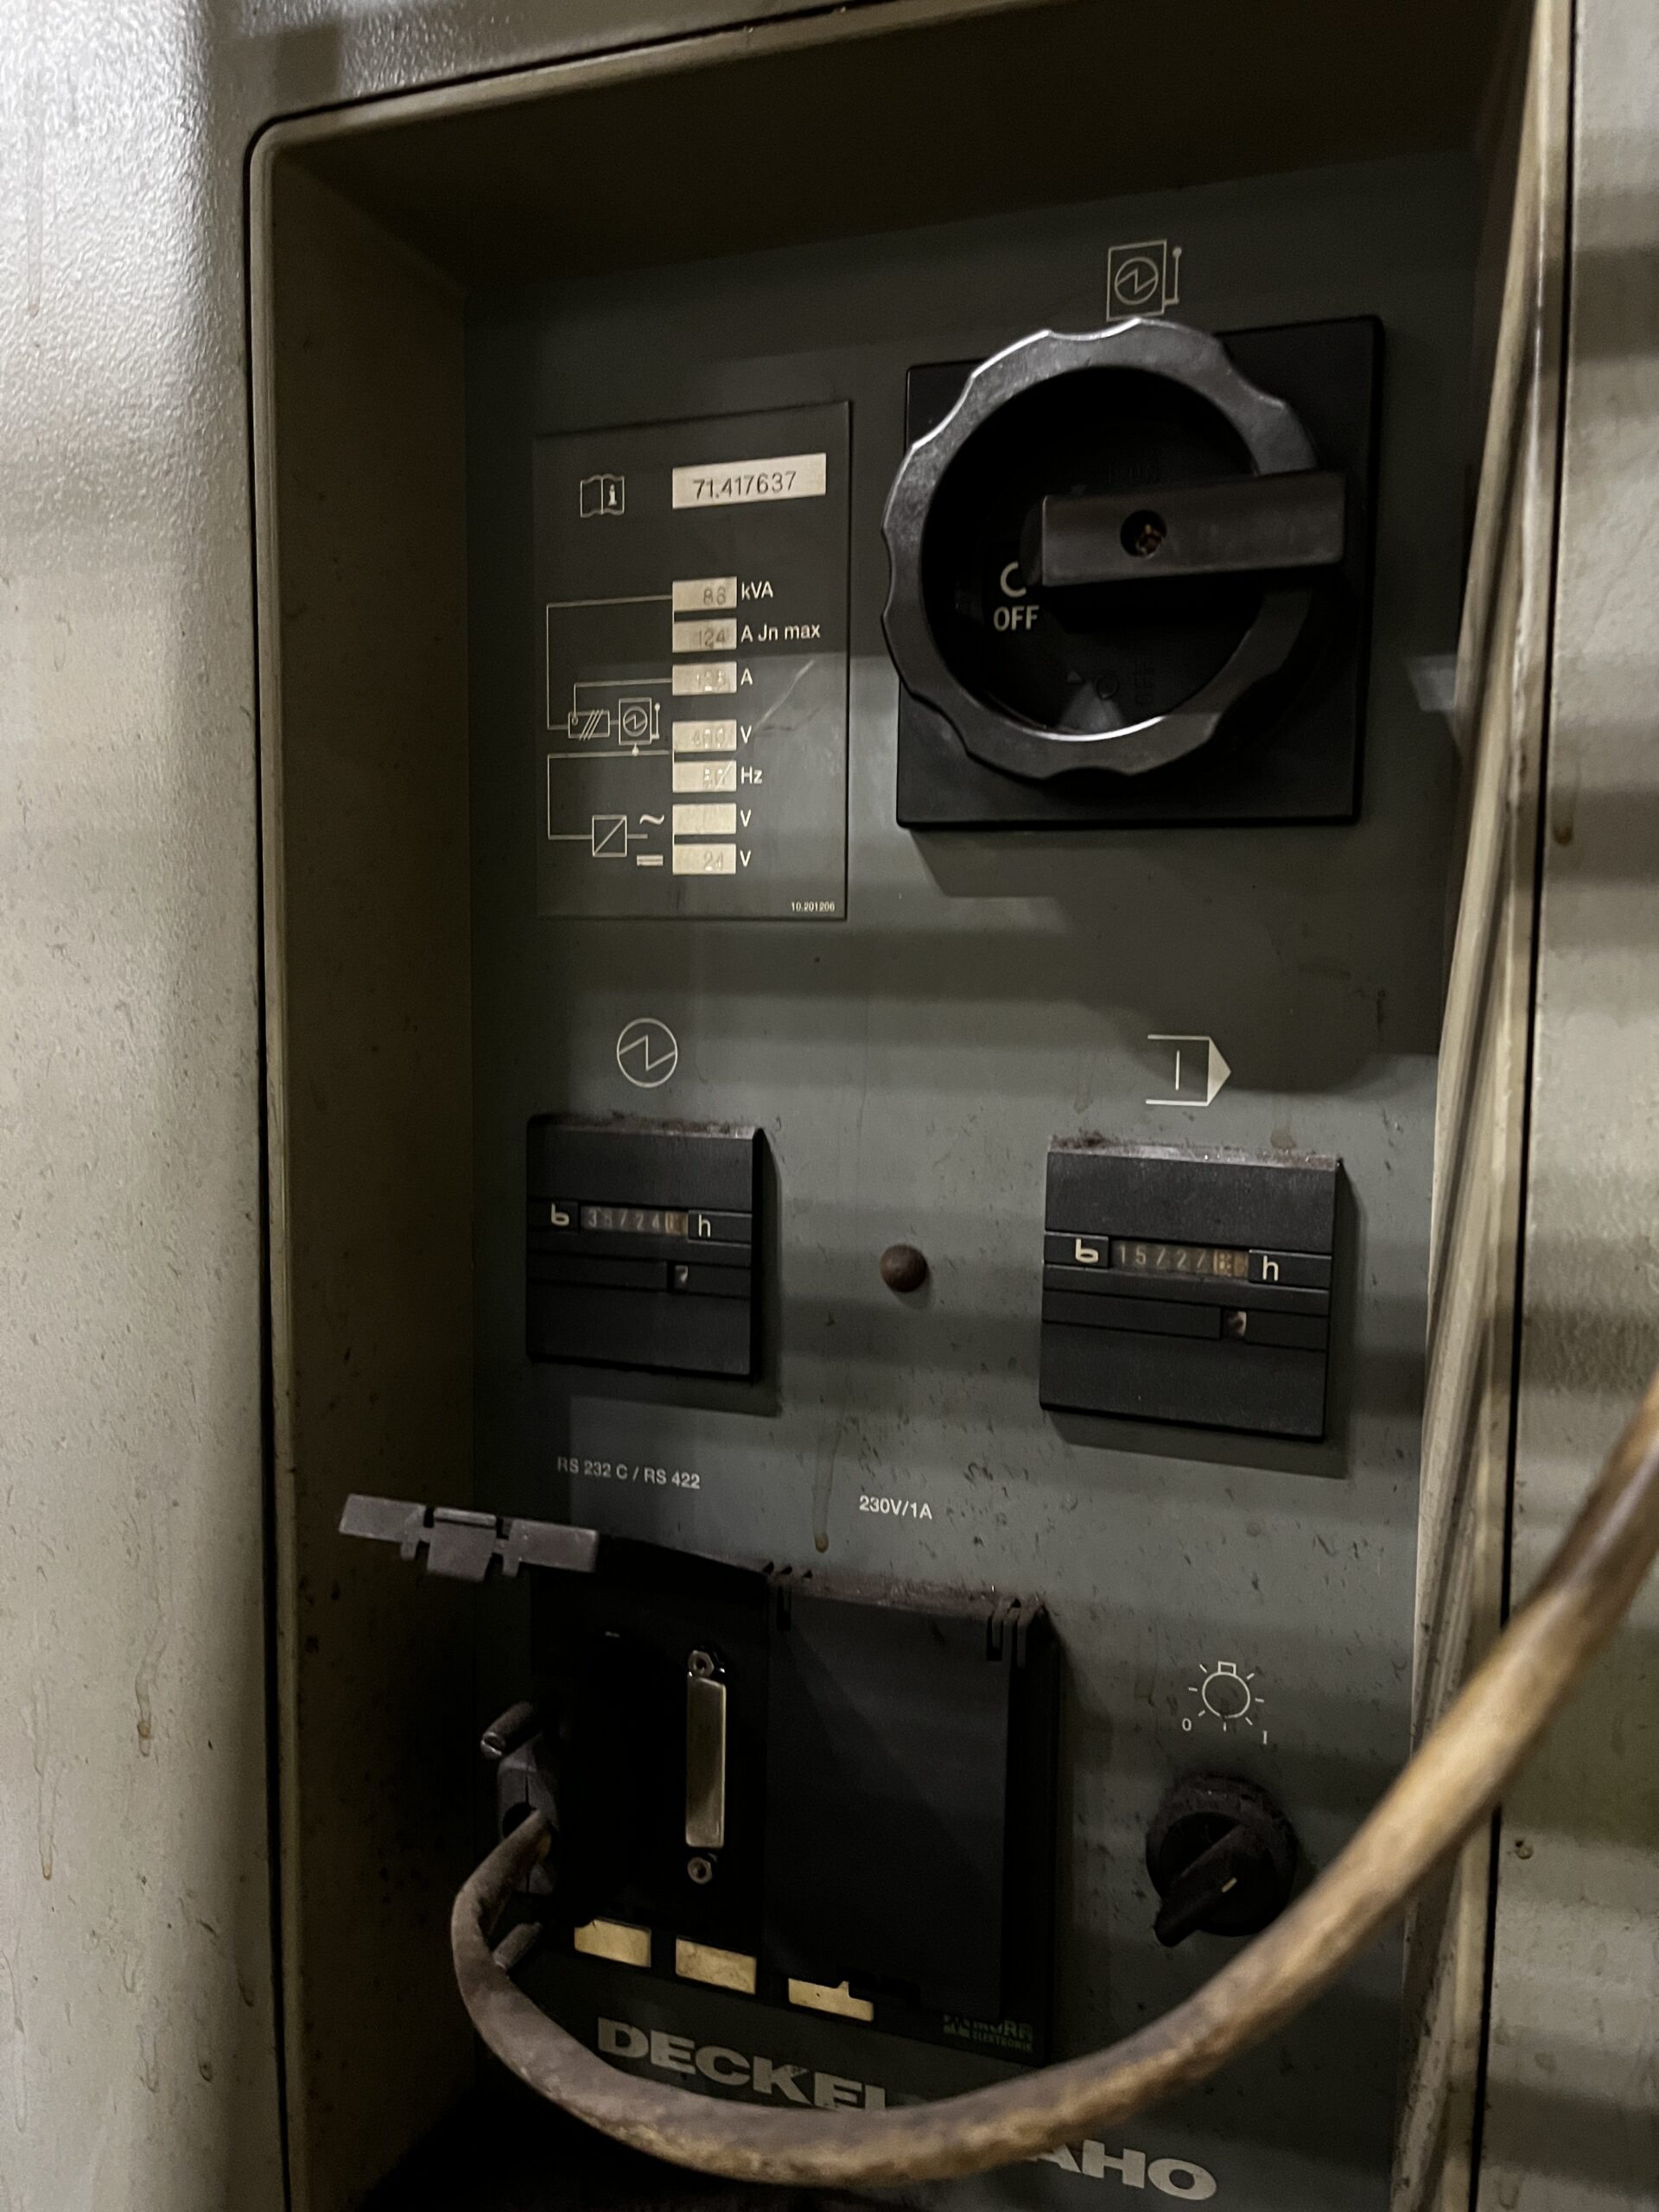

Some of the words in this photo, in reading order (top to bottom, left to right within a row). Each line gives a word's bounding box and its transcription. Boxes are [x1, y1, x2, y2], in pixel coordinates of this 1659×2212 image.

[692, 471, 797, 500] 71.417637
[741, 581, 773, 600] kVA
[993, 605, 1039, 632] OFF
[741, 626, 753, 643] A
[784, 623, 822, 639] max
[741, 668, 753, 685] A
[740, 725, 753, 744] V
[741, 766, 763, 784] Hz
[740, 809, 753, 828] V
[739, 849, 752, 868] V
[698, 1214, 711, 1237] h
[1262, 1255, 1279, 1281] h
[557, 1457, 578, 1473] RS
[584, 1460, 612, 1477] 232
[616, 1464, 628, 1480] C
[644, 1467, 667, 1485] RS
[671, 1471, 701, 1490] 422
[859, 1495, 932, 1520] 230V/1A
